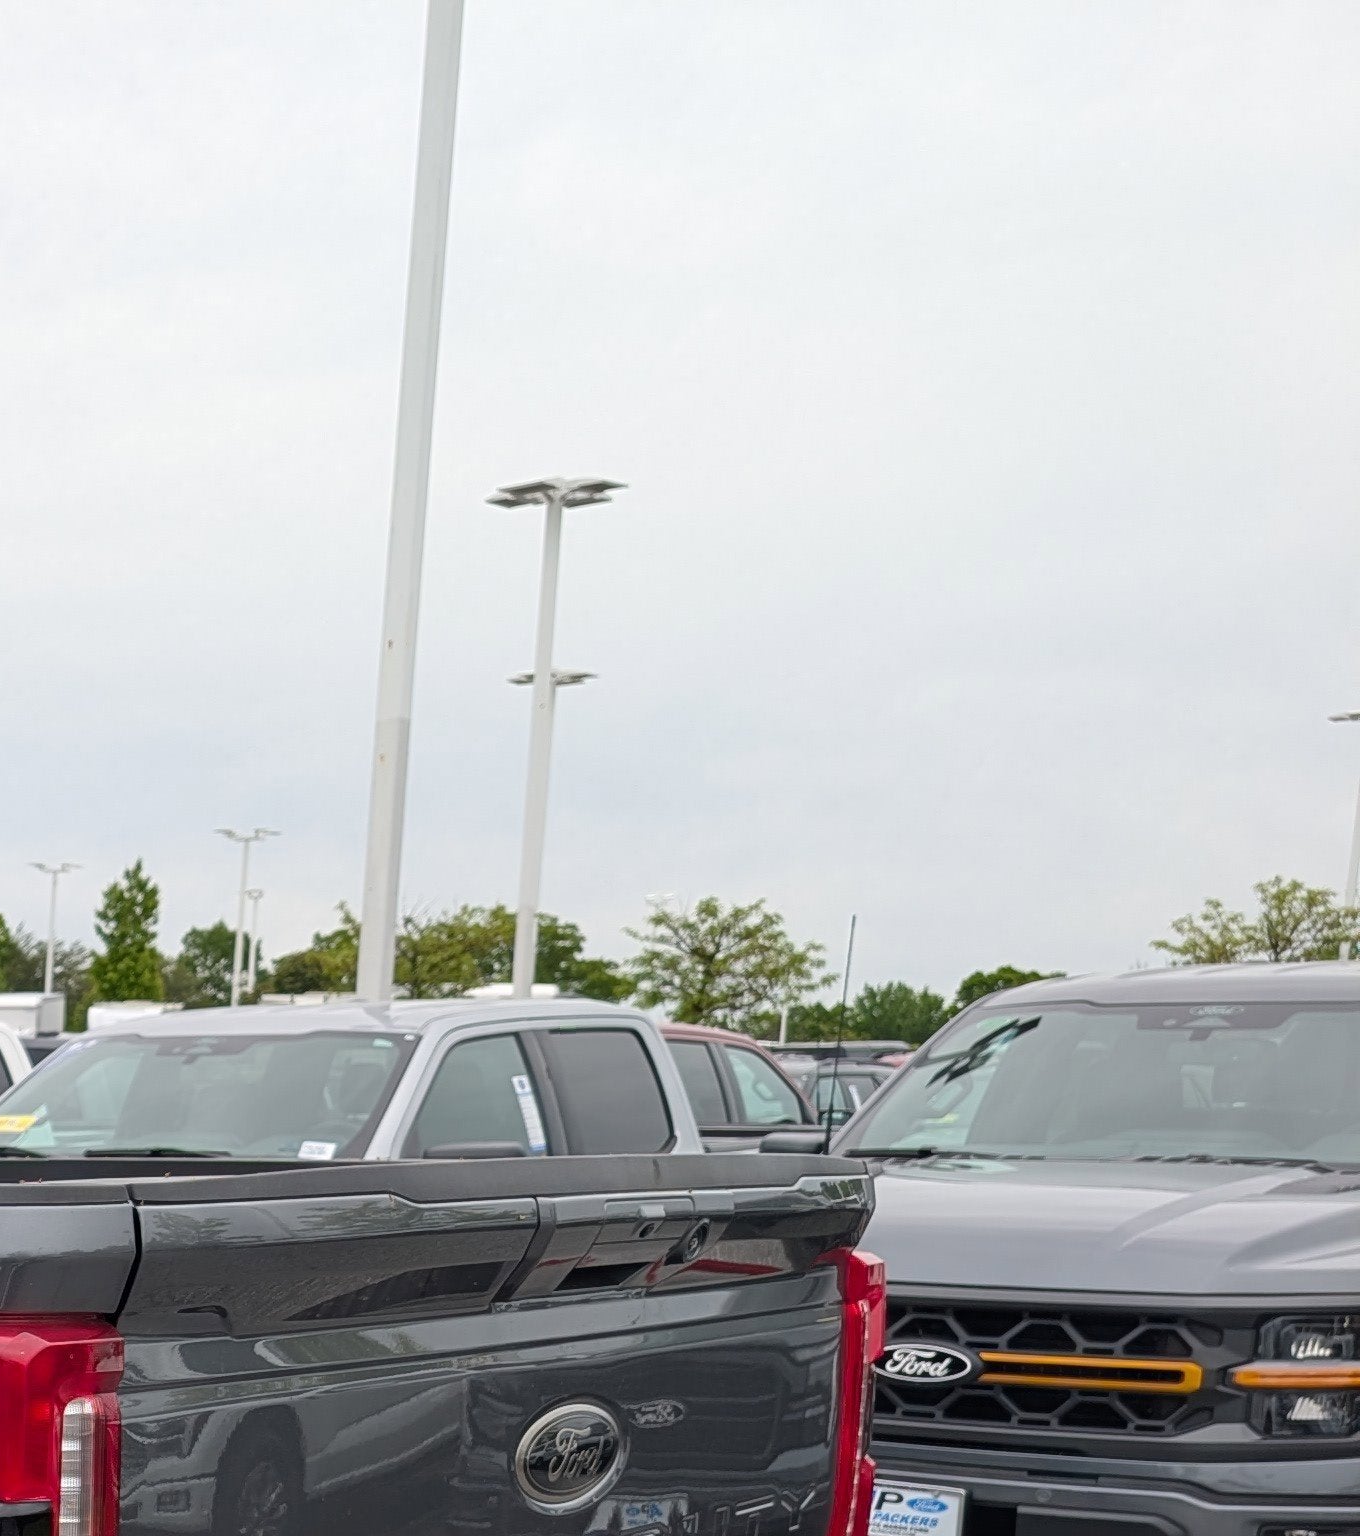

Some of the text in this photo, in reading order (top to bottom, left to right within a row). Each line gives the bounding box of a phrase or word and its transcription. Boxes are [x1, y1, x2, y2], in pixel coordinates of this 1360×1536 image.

[884, 1348, 950, 1377] Ford
[548, 1426, 606, 1483] Ford
[873, 1490, 904, 1511] P
[873, 1512, 940, 1528] PACKERS
